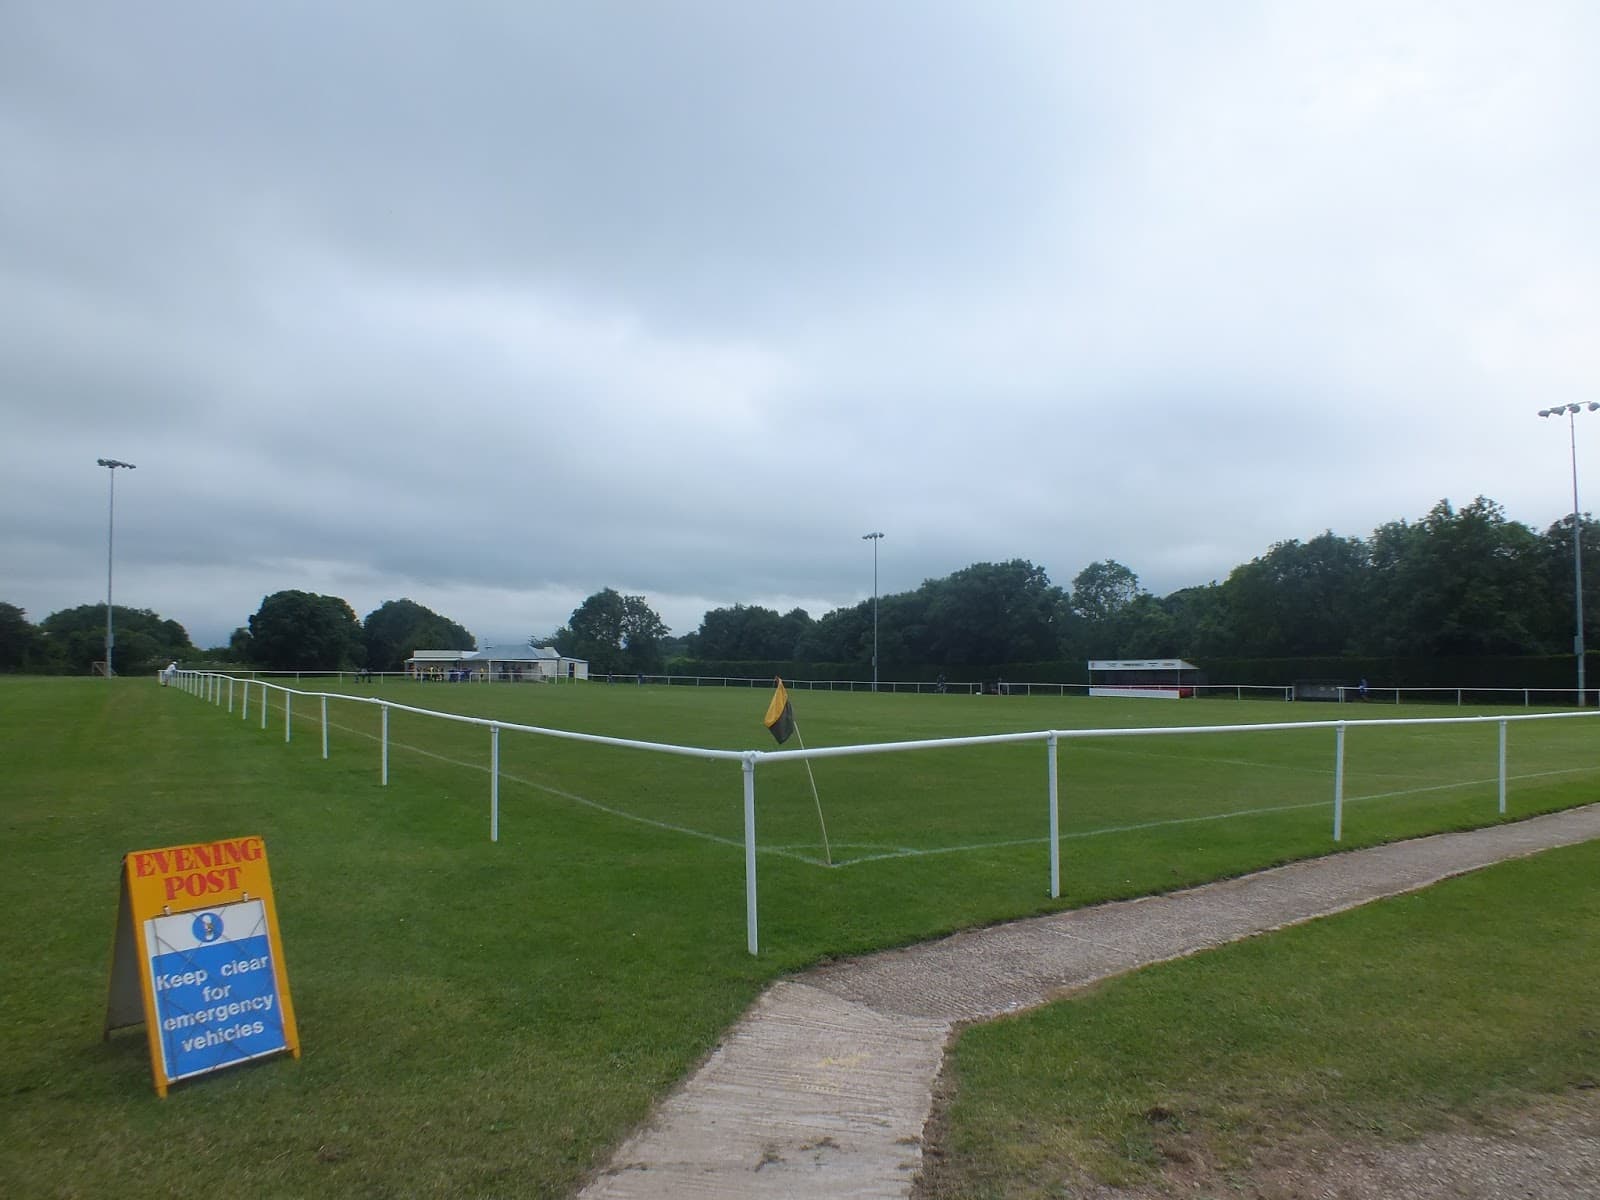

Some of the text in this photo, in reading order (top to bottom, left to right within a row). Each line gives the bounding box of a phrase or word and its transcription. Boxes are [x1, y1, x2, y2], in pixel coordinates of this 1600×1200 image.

[135, 838, 262, 877] EVENING
[164, 866, 241, 900] POST
[156, 954, 269, 991] Keep clear
[202, 983, 232, 1002] for
[164, 993, 273, 1031] emergency
[181, 1019, 265, 1053] vehicles
